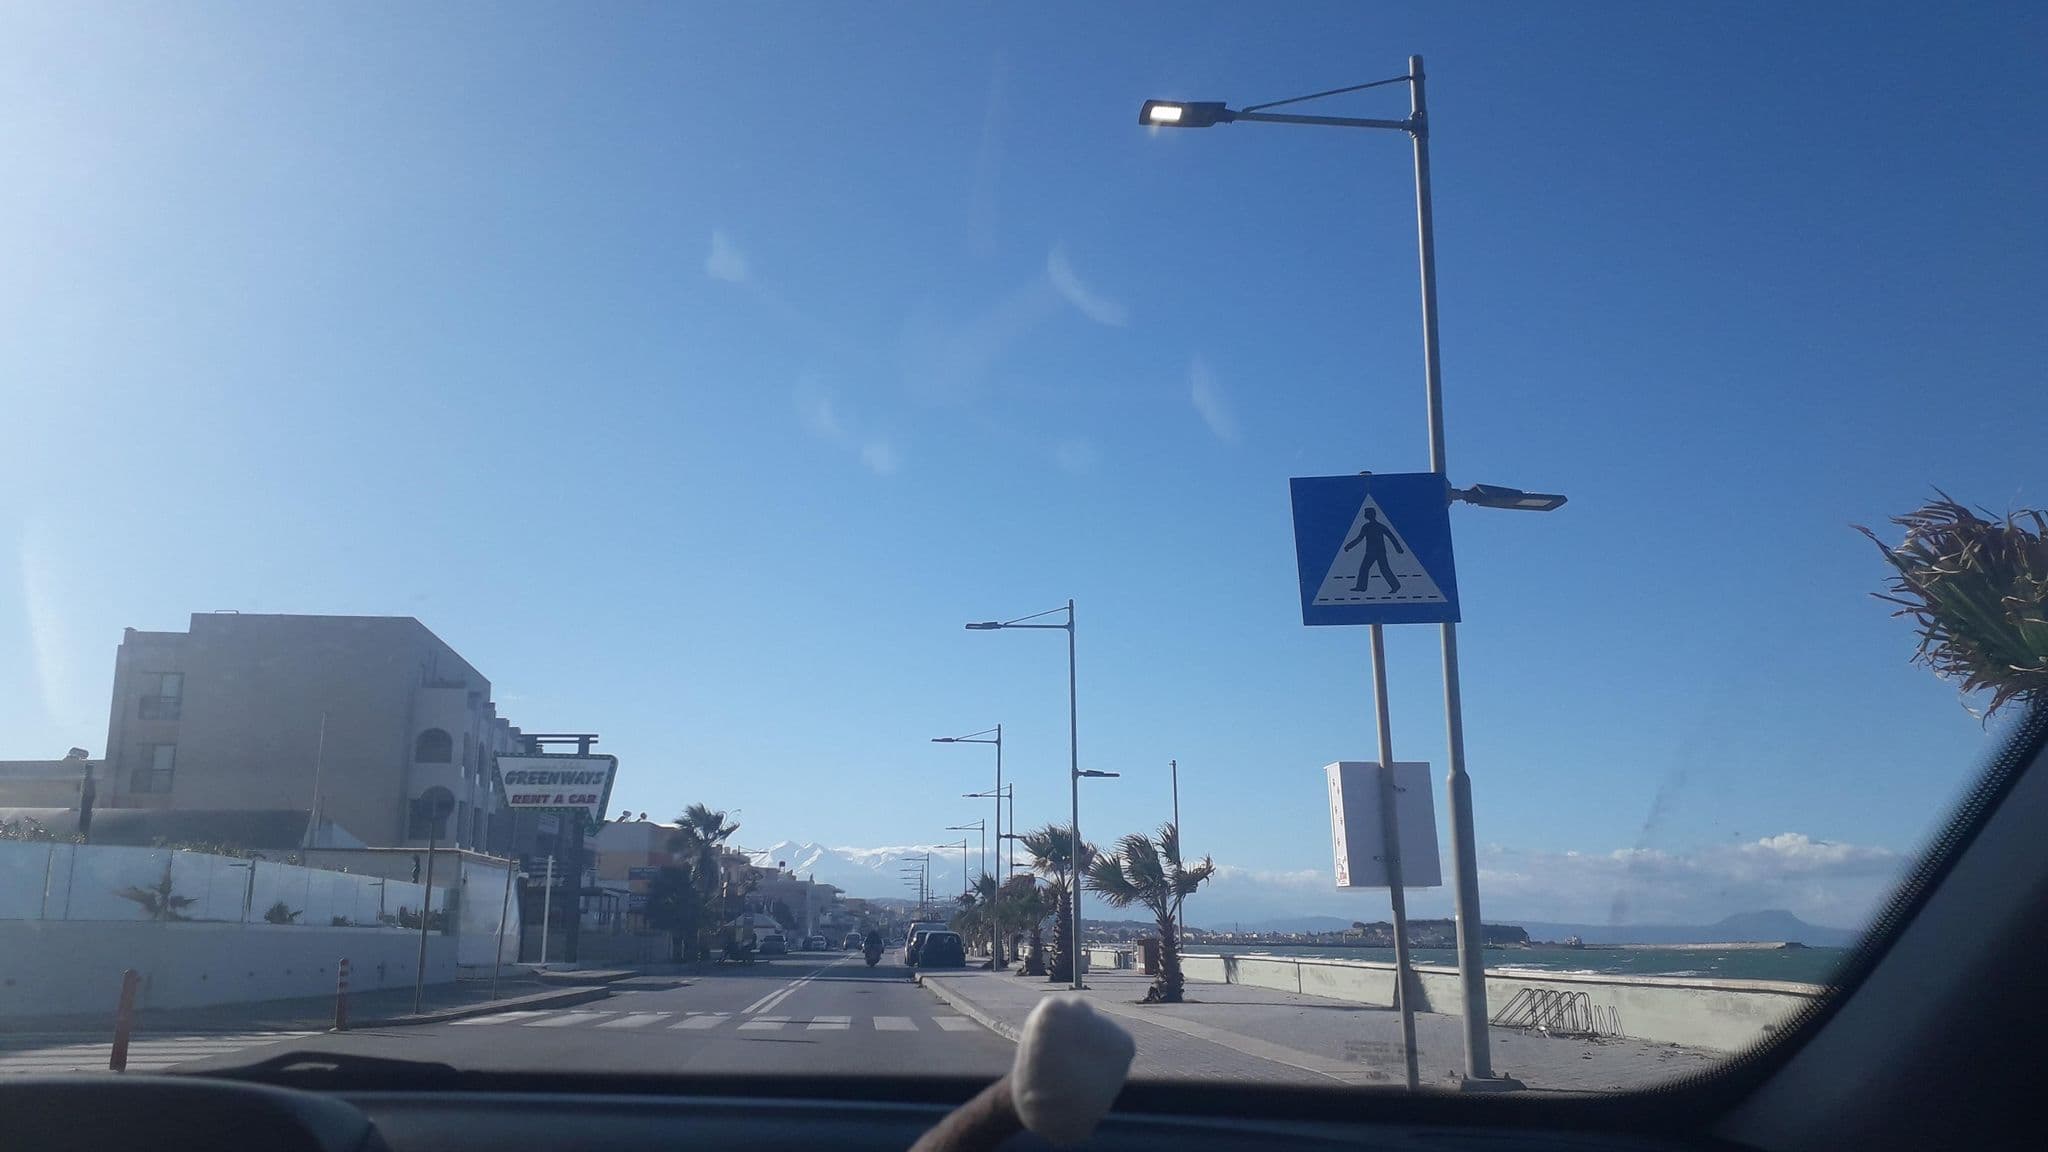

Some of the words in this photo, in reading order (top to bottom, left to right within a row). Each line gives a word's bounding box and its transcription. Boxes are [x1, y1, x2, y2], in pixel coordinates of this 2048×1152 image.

[504, 770, 605, 785] GREENWAYS
[511, 794, 550, 804] RENT
[553, 794, 564, 804] A
[568, 794, 598, 804] CAR
